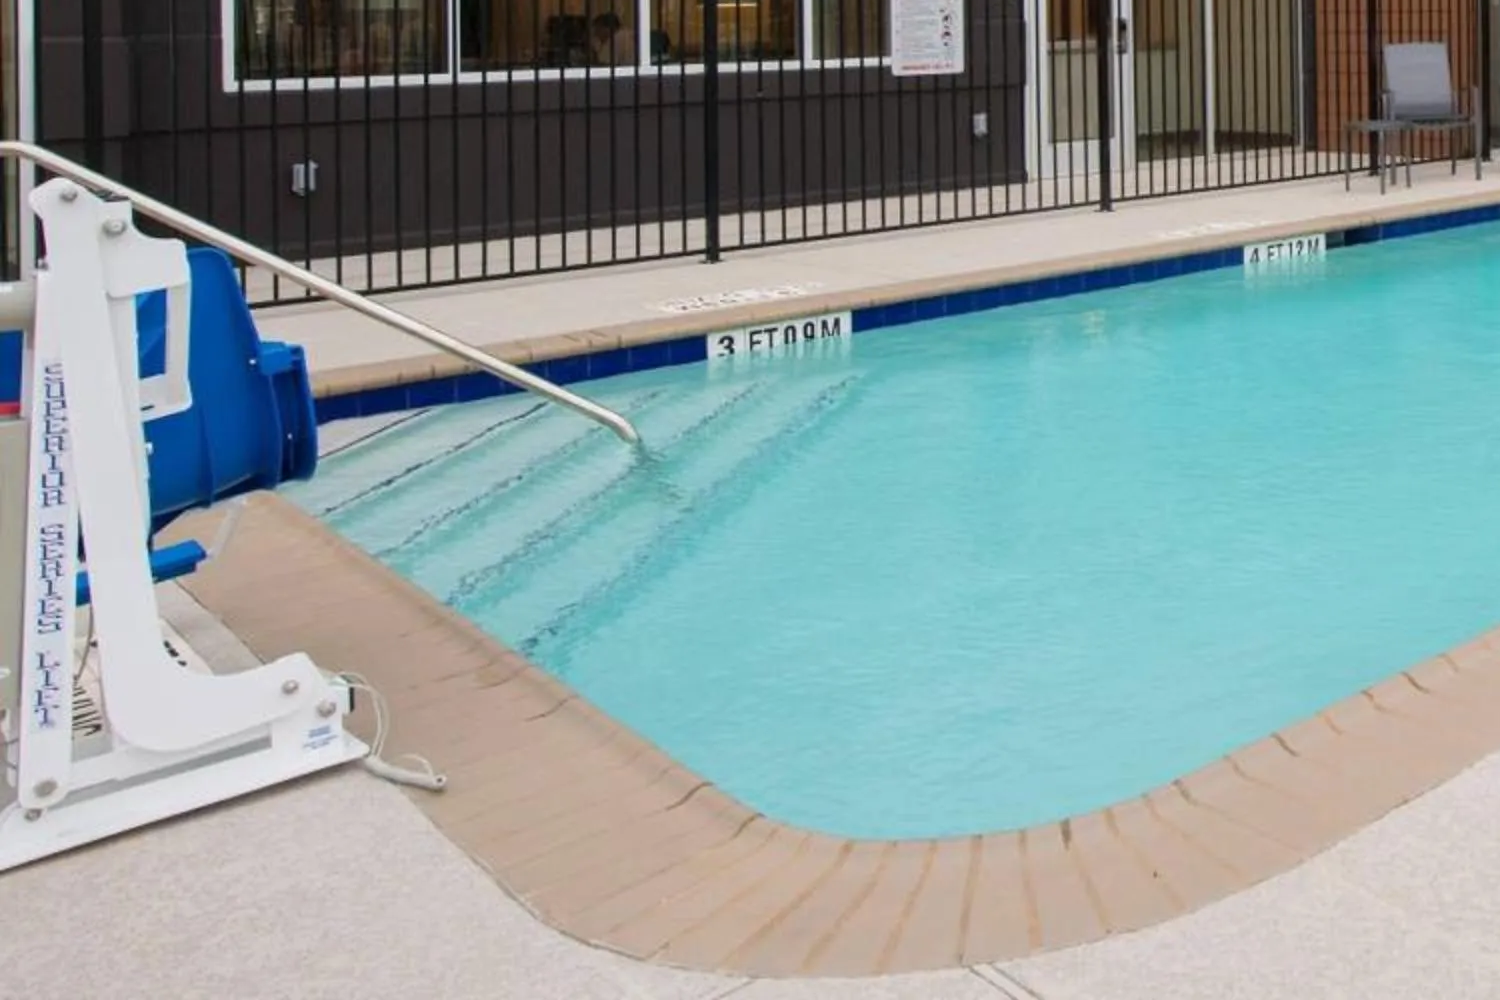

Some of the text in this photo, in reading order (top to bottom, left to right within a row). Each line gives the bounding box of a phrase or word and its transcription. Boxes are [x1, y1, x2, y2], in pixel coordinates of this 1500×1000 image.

[717, 335, 735, 357] 3
[34, 362, 68, 728] SUPERIOR SERIES LIFT
